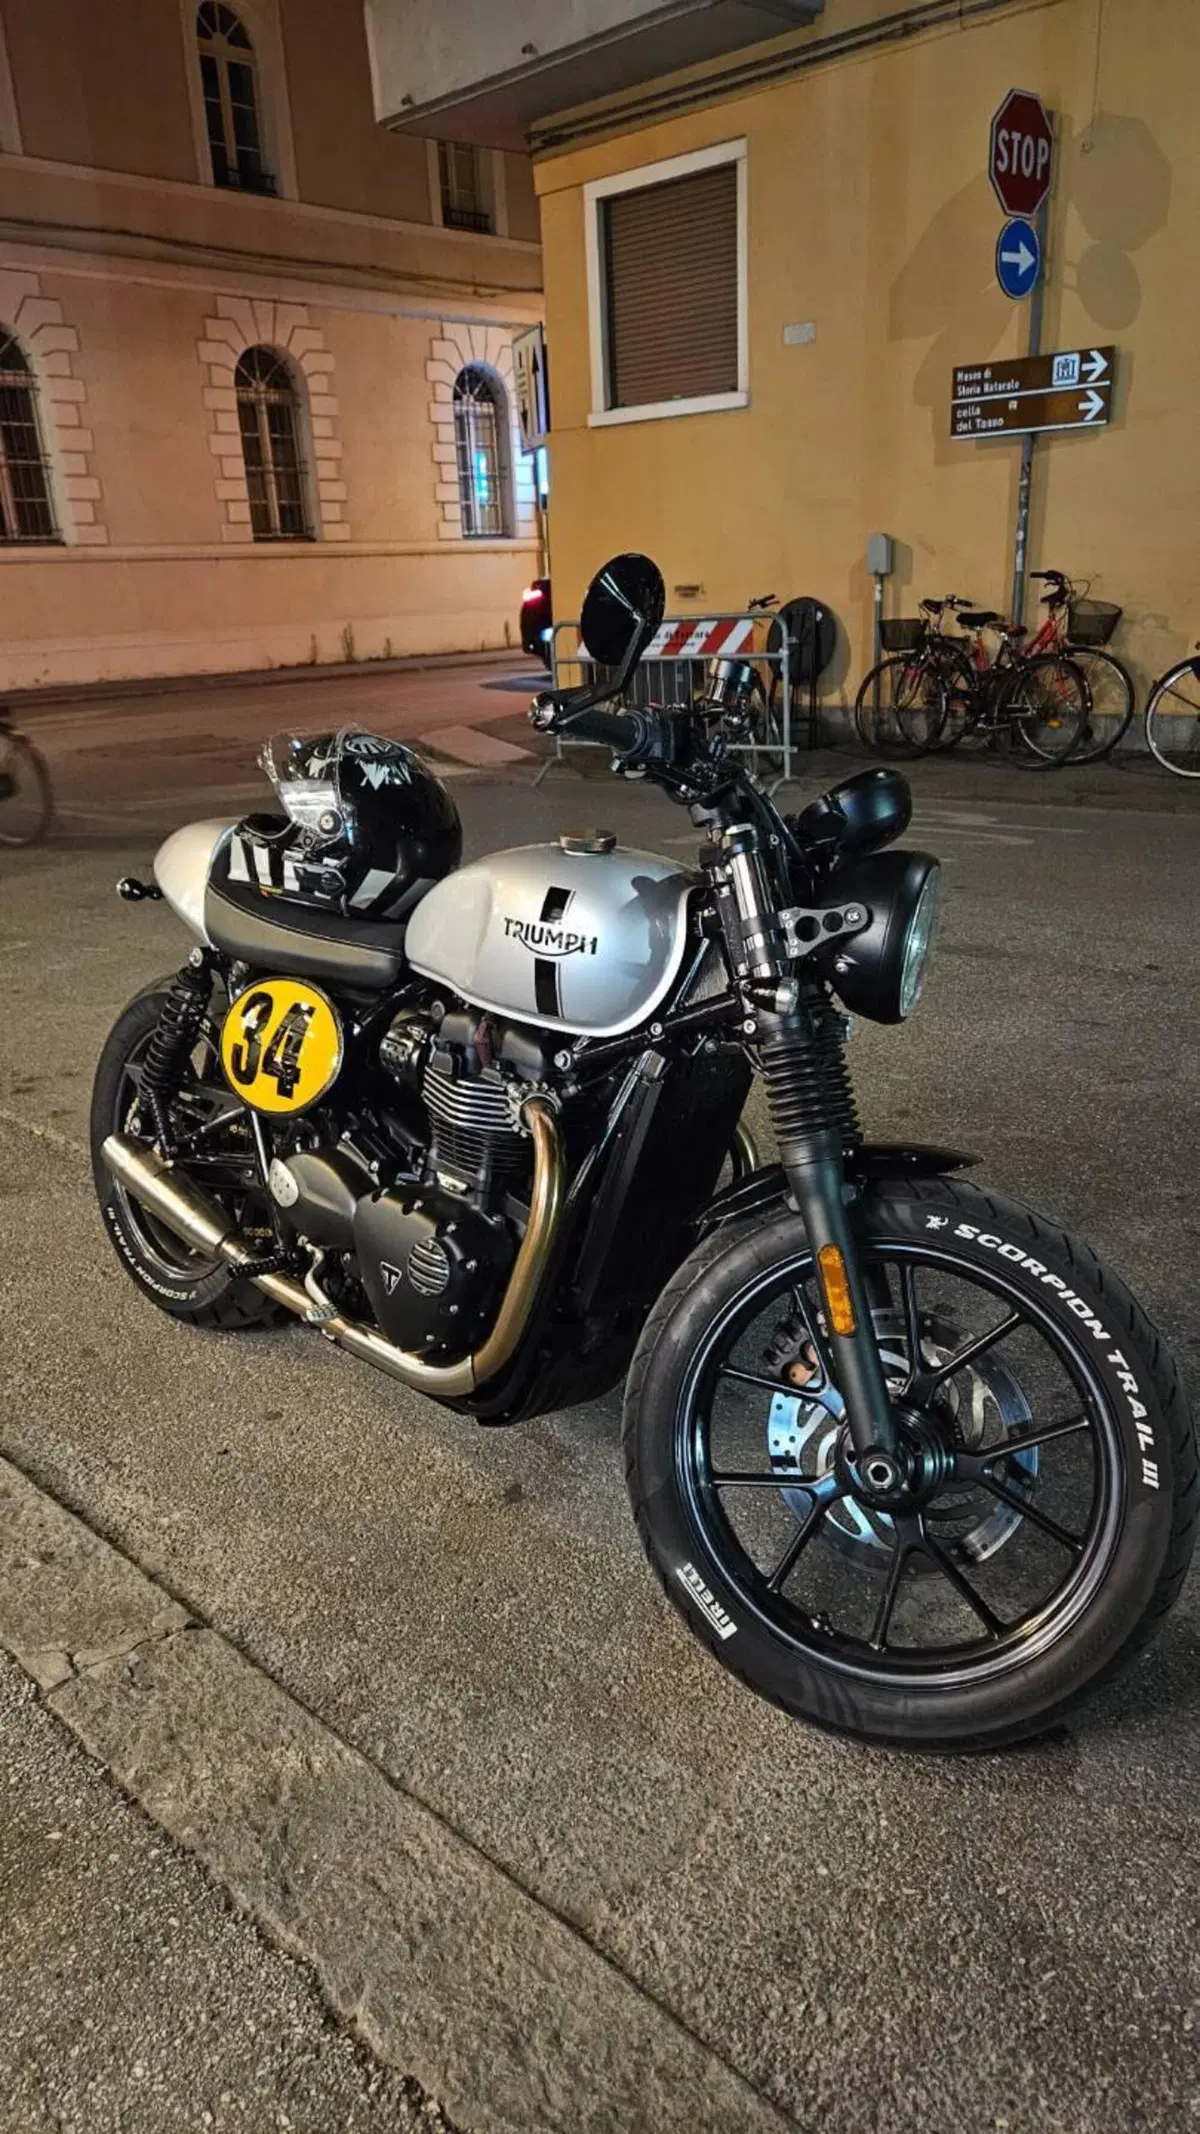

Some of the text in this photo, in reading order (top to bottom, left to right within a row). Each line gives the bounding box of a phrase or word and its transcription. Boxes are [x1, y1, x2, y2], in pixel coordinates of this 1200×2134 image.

[996, 128, 1049, 180] STOP
[957, 379, 1020, 397] Storia Naturale
[983, 367, 992, 379] di
[956, 405, 981, 418] cella
[956, 419, 972, 432] del
[504, 917, 598, 956] TRIUMPH
[231, 991, 316, 1100] 34
[136, 1266, 188, 1301] SCORPION
[954, 1223, 1111, 1340] SCORPION
[1106, 1349, 1155, 1452] TRAIL
[676, 1562, 738, 1640] PIRELLI
